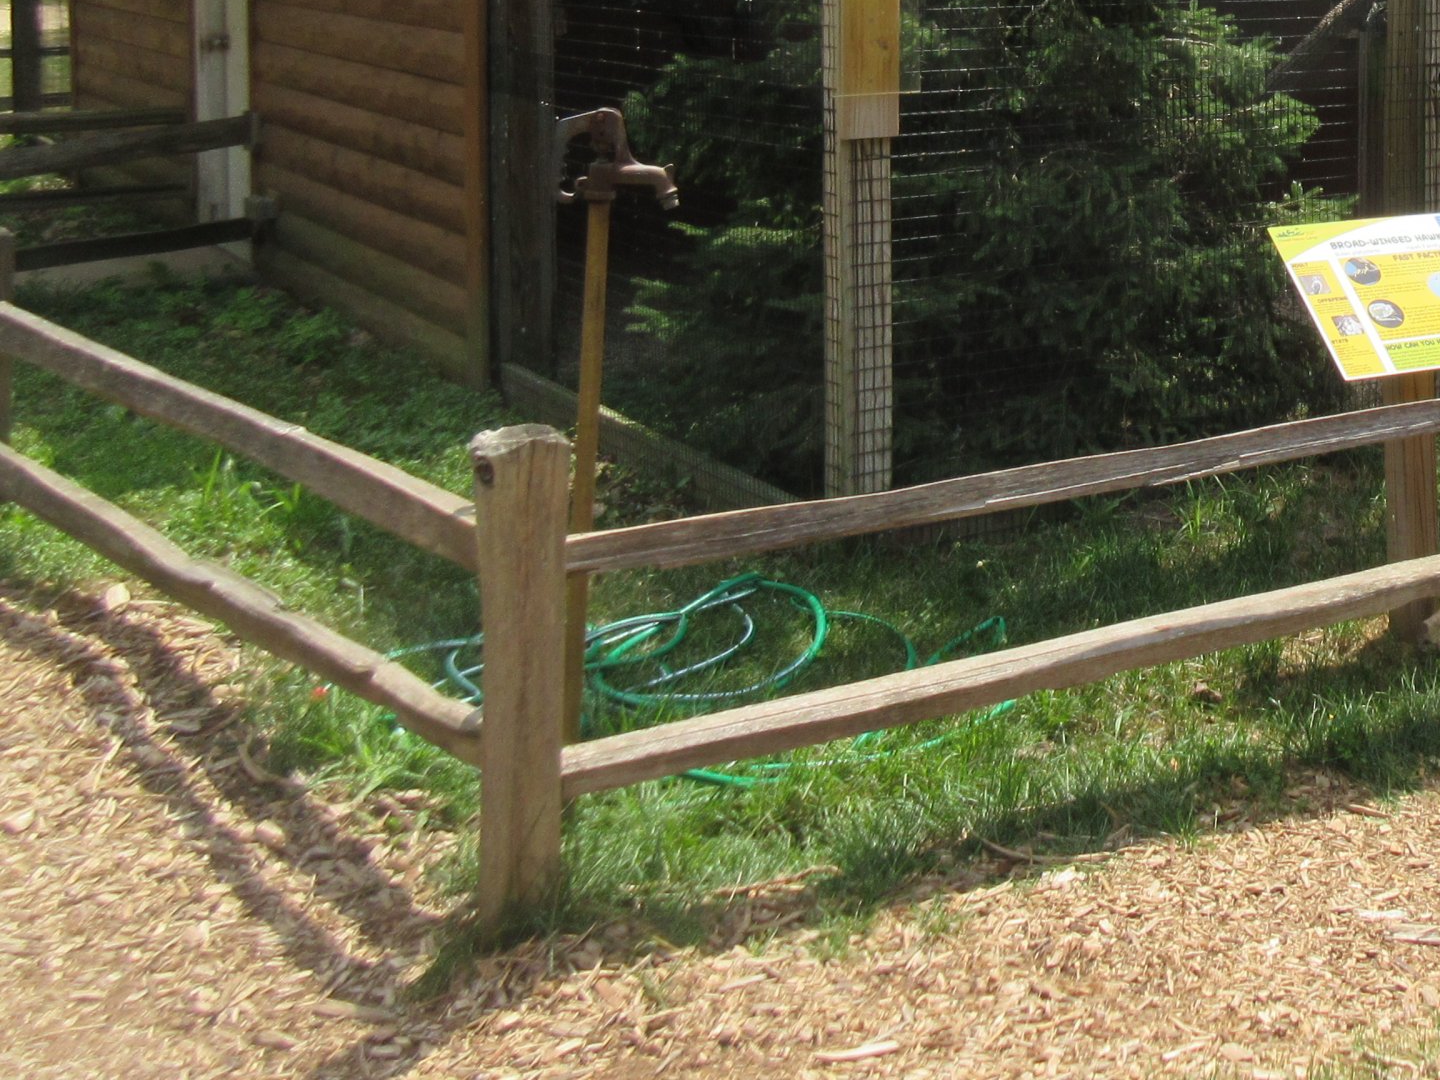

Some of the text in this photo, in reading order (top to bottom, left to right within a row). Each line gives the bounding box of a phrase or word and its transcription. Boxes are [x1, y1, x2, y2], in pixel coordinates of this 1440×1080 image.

[1329, 236, 1412, 250] BROAD-WINGED
[1385, 342, 1404, 352] HOW
[1404, 340, 1419, 349] CAN
[1420, 338, 1435, 346] YOU
